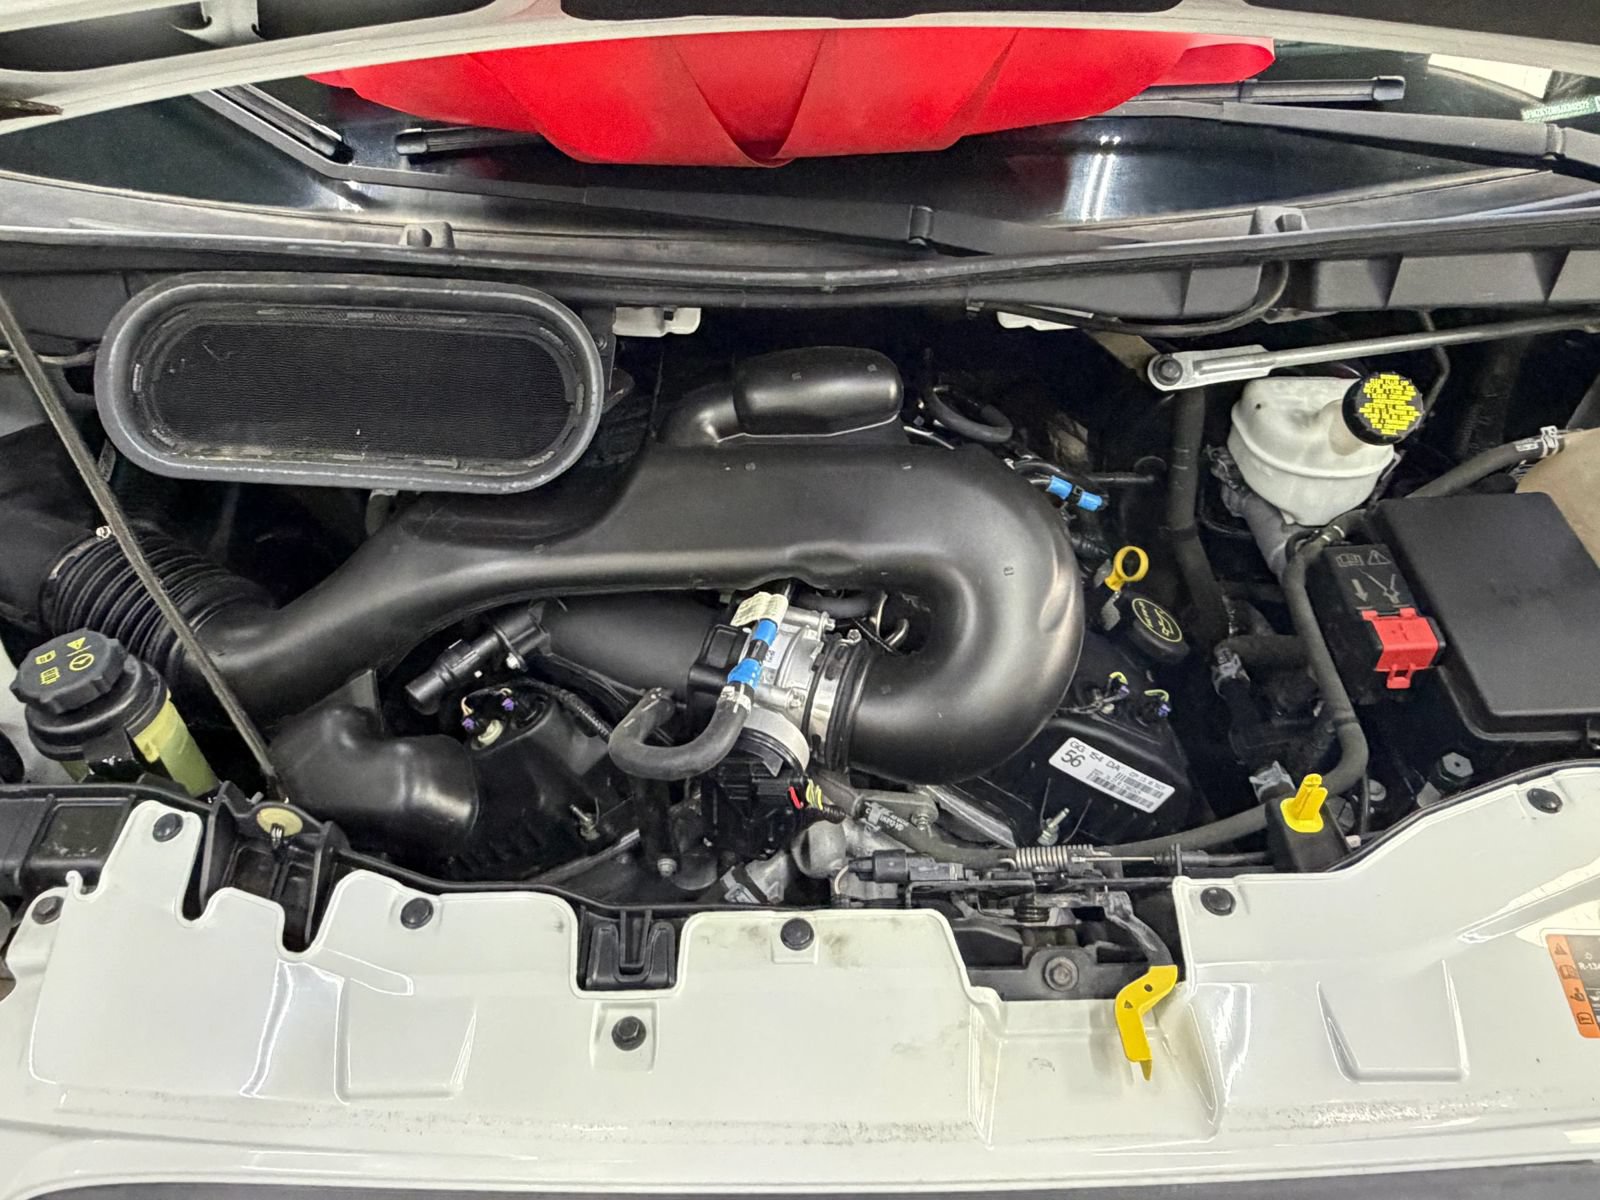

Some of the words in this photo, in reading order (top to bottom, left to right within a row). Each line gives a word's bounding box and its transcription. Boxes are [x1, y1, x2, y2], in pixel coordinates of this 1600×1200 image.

[1061, 749, 1086, 768] 56
[1069, 741, 1086, 753] GG
[1105, 760, 1121, 772] DA
